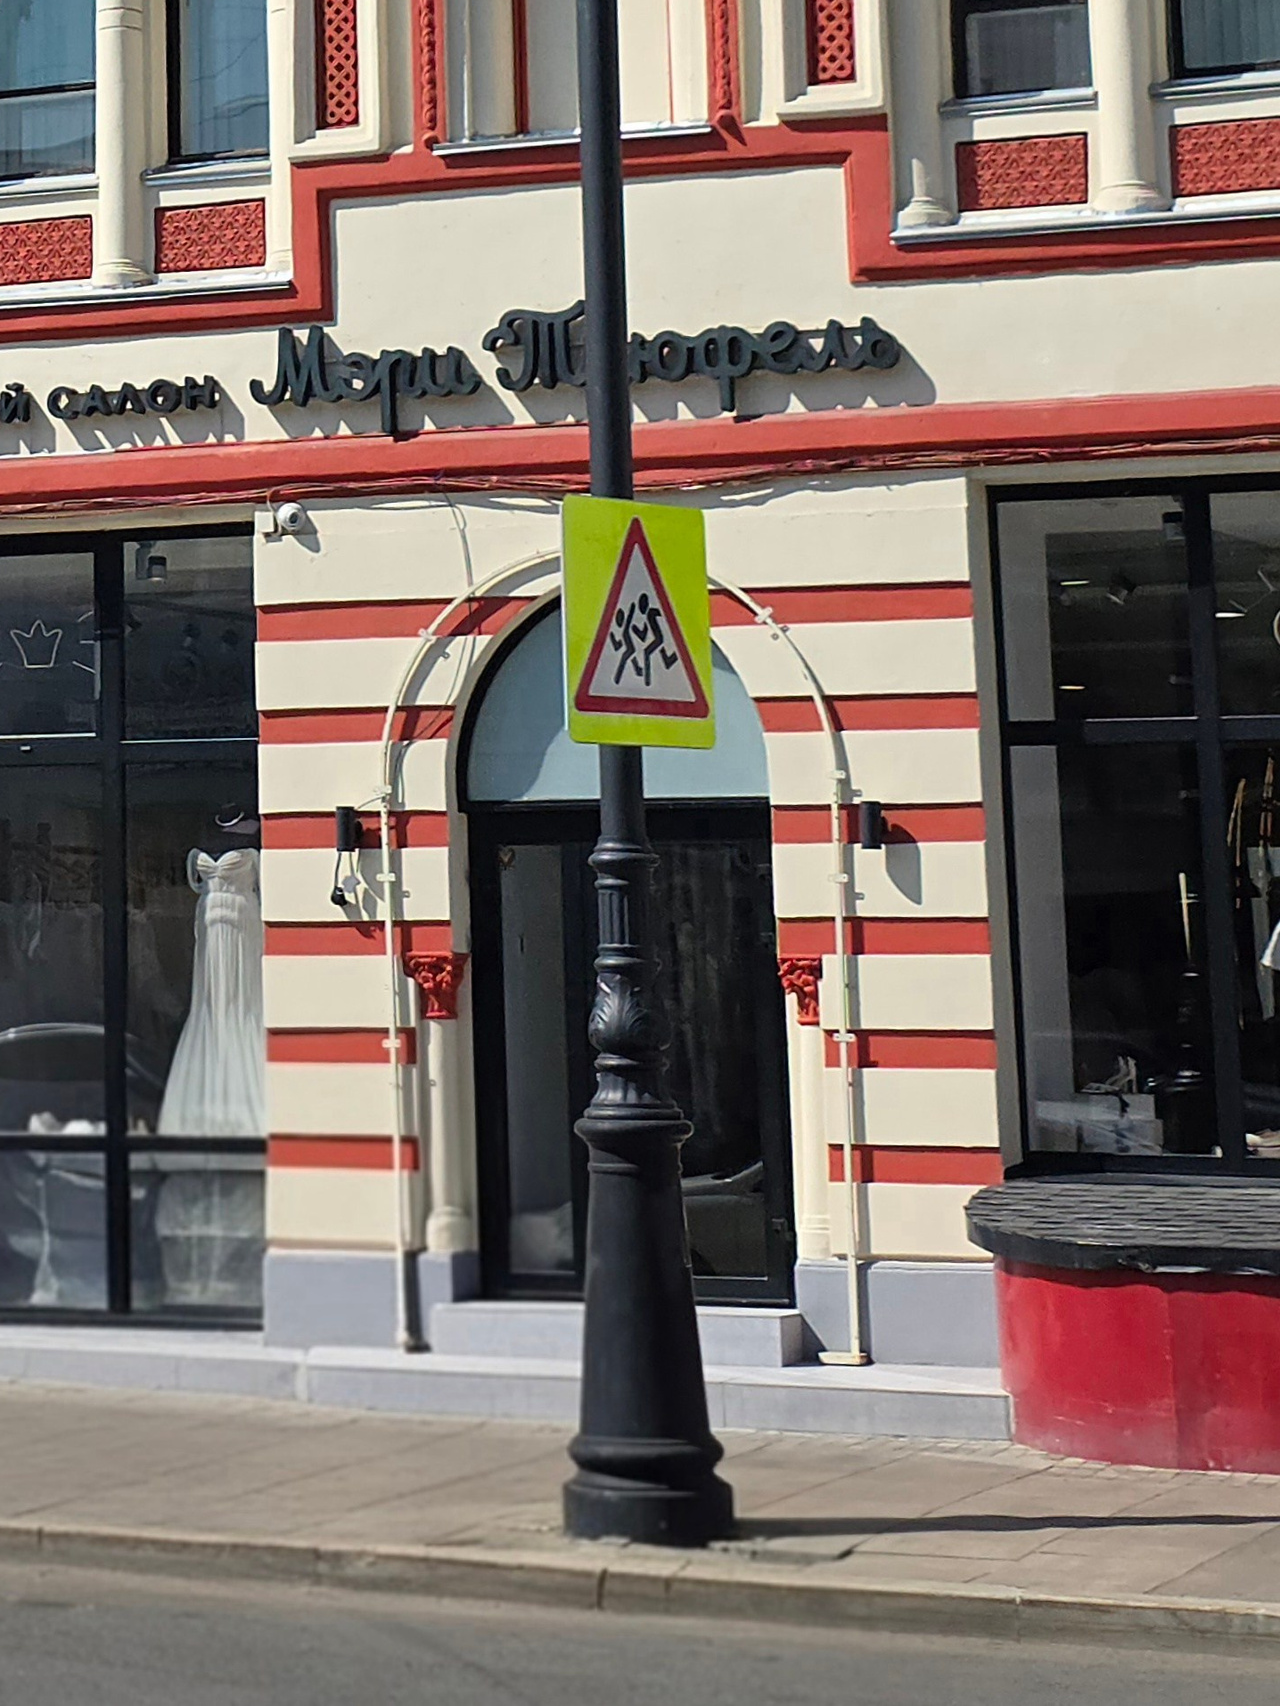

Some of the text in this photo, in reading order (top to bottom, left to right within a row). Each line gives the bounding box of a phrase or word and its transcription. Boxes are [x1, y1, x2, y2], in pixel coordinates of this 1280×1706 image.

[46, 375, 219, 419] САЛОН
[249, 325, 481, 438] Мэри
[482, 300, 901, 412] Тюфель
